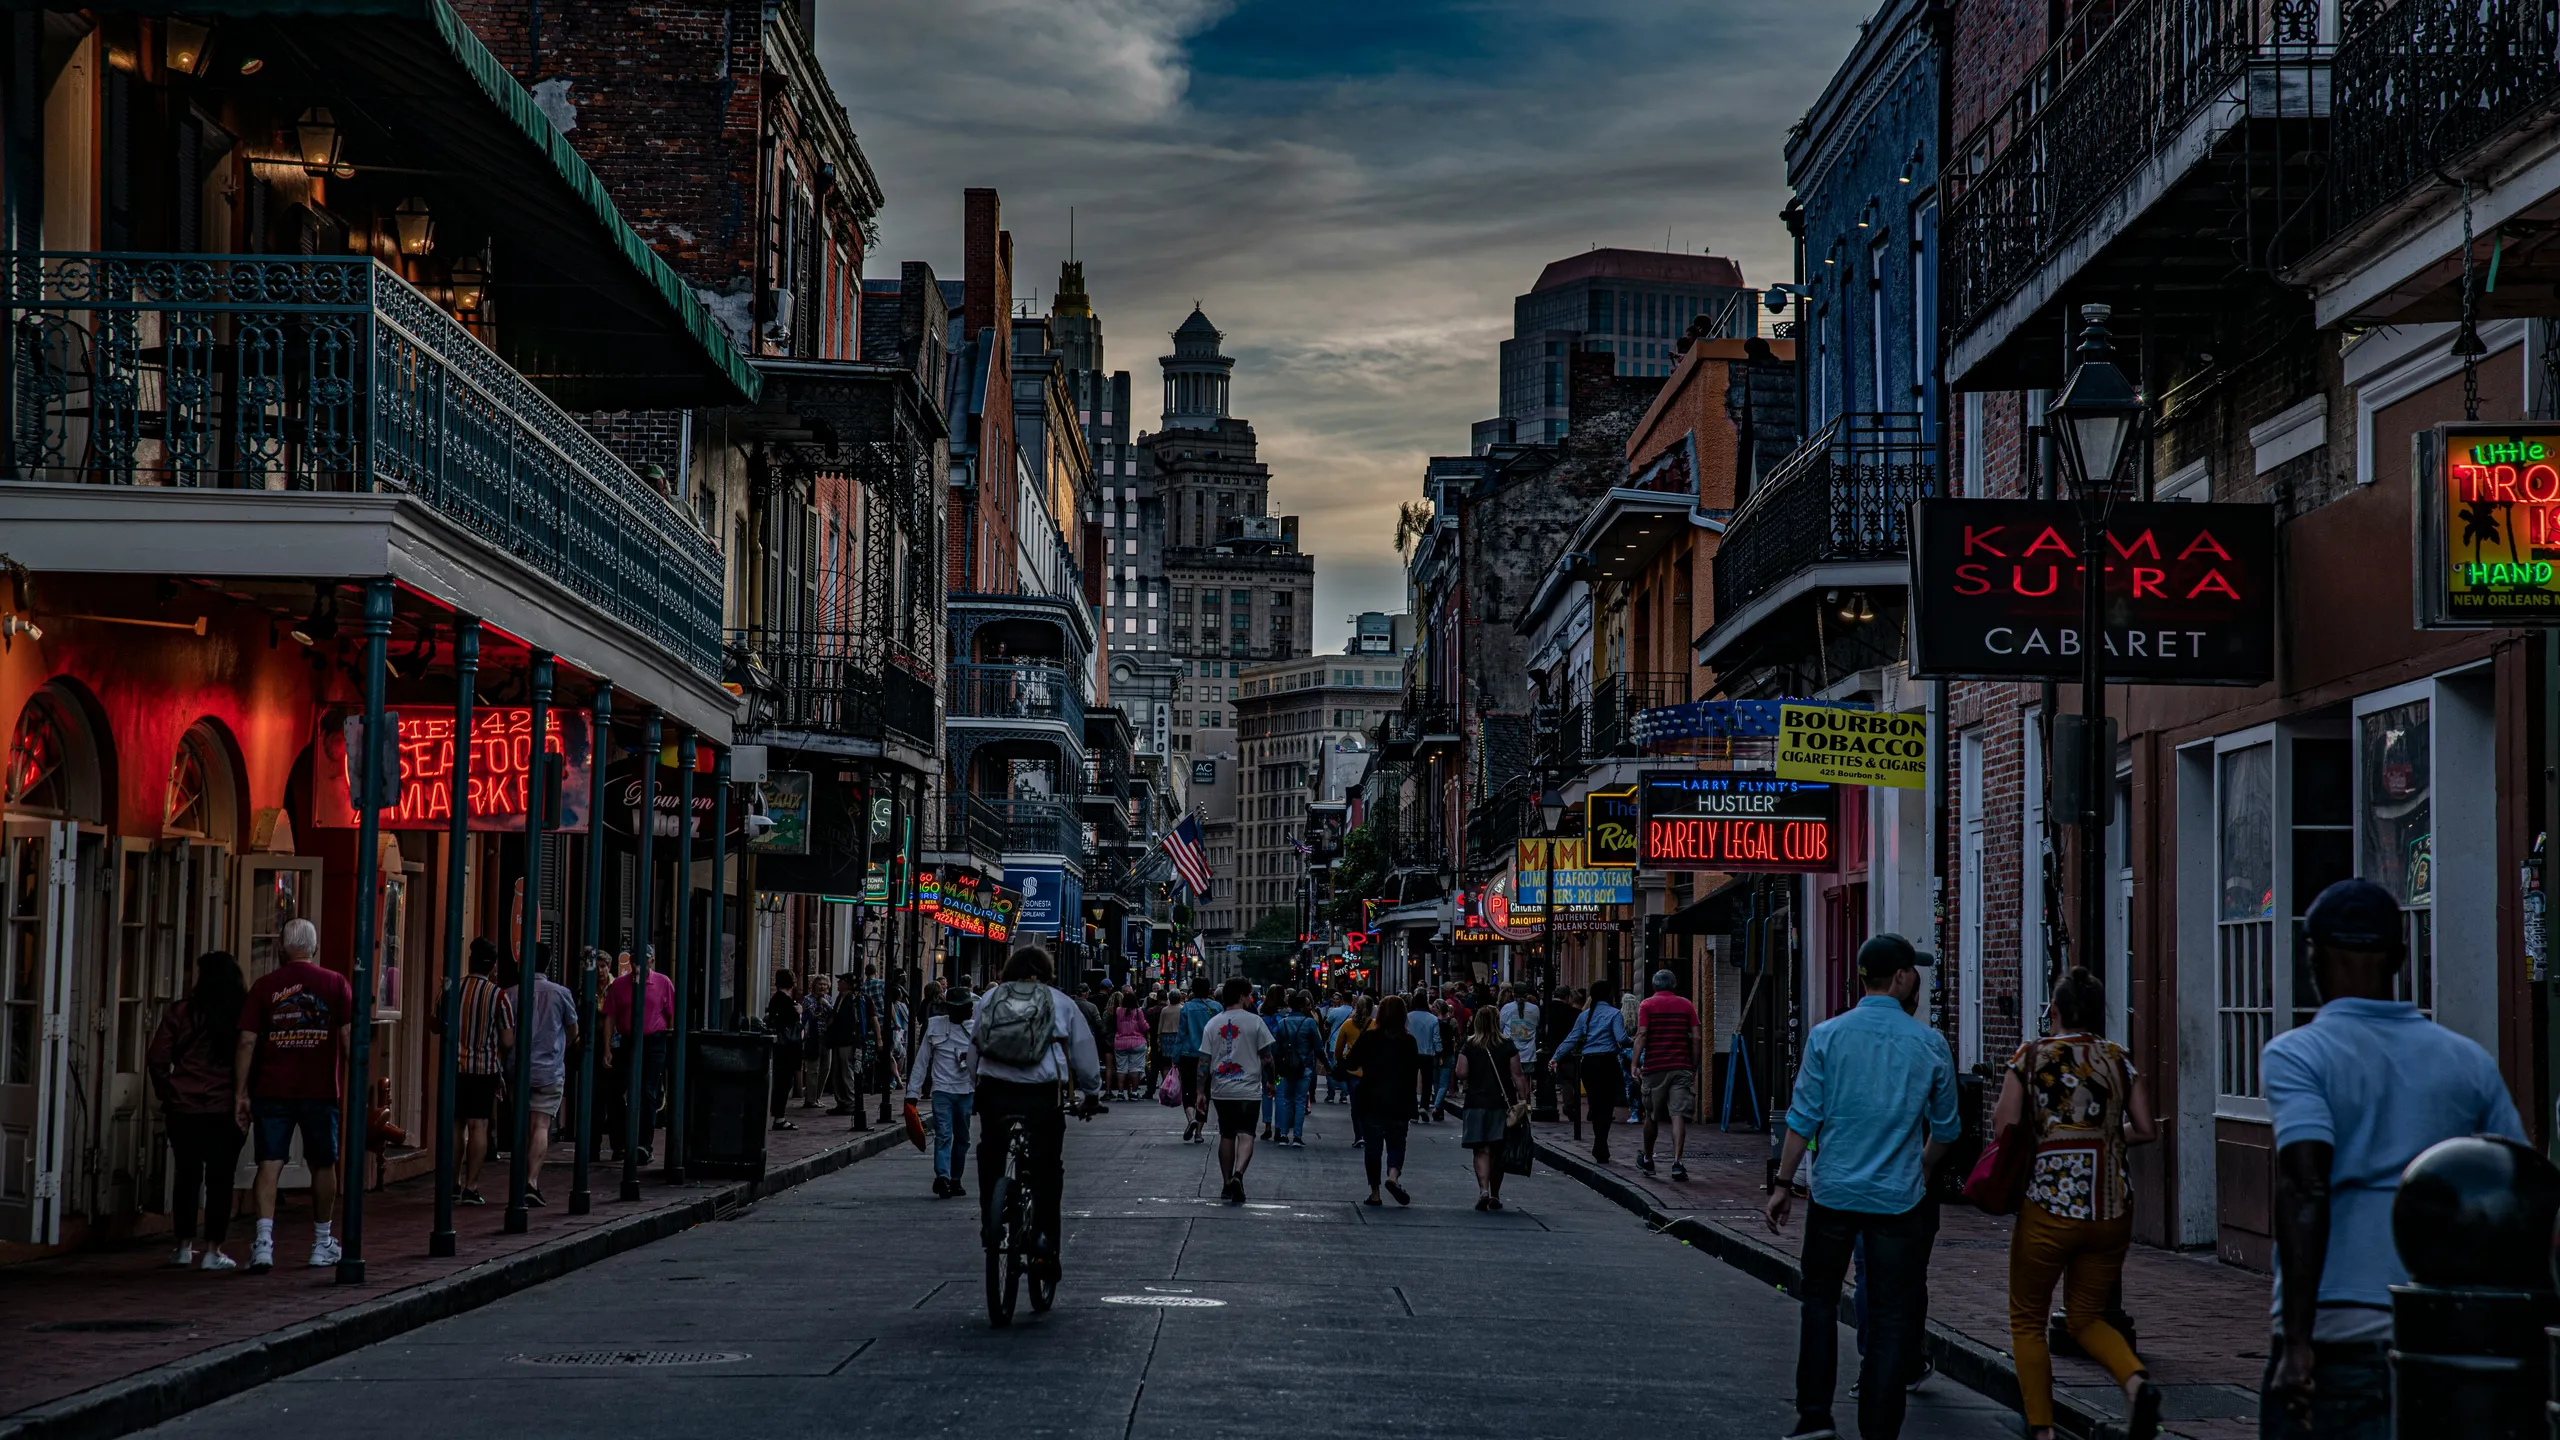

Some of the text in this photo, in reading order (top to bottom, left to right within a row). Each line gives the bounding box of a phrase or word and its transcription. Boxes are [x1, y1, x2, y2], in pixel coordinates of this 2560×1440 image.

[2474, 440, 2546, 465] Little
[1963, 524, 2233, 562] KAMA
[2465, 560, 2553, 586] HAND
[2454, 594, 2485, 607] NEW
[2487, 594, 2551, 607] ORLEANS
[1984, 627, 2208, 659] CABARET
[1784, 710, 1926, 738] BOURBON
[1787, 731, 1924, 758] TOBACCO
[1195, 763, 1213, 773] AC
[1781, 750, 1926, 773] CIGARETTES & CIGARS
[1819, 768, 1886, 781] 425 Bourbon St.
[1682, 780, 1799, 792] LARRY FLYNT'S
[765, 791, 804, 809] EAUX
[1603, 800, 1637, 817] The
[1650, 821, 1828, 861] BARELY LEGAL CLUB
[1519, 871, 1633, 887] GUMB SEAFOOD STEAKS
[934, 912, 953, 924] PIZZA
[943, 897, 1005, 923] DAIQUIRIS
[1553, 913, 1598, 921] AUTHENTIC
[988, 922, 1007, 933] EER
[1588, 922, 1620, 931] CUISINE
[269, 1029, 329, 1041] GILLETTE
